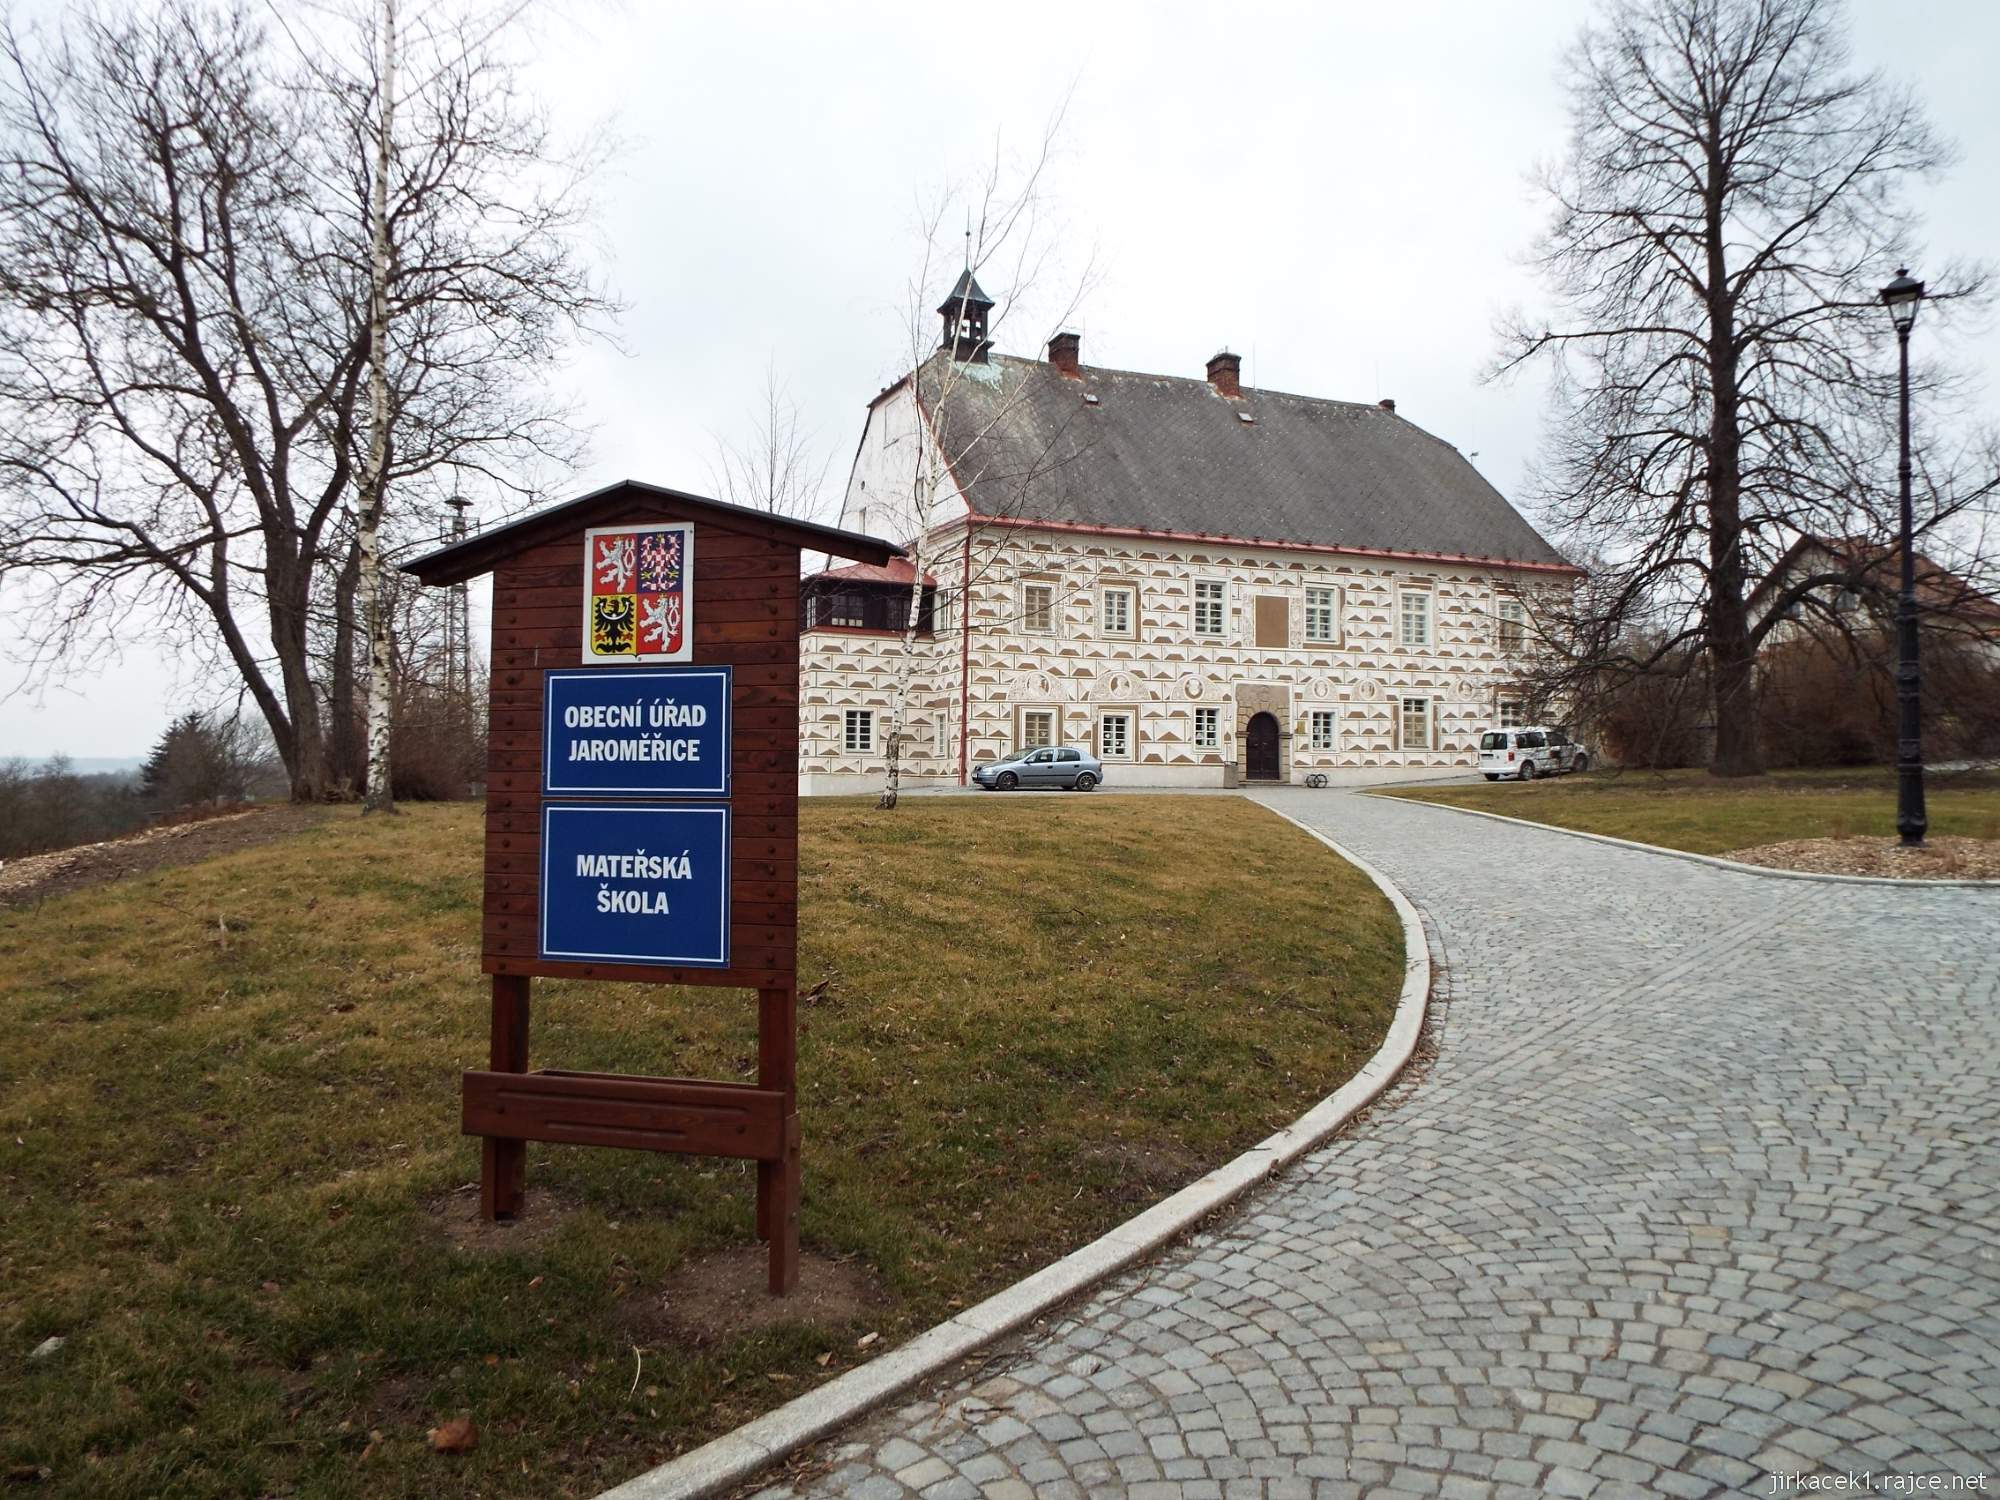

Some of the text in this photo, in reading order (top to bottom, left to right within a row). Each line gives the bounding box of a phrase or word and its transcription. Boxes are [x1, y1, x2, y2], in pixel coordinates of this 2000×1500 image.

[565, 698, 707, 728] OBECNÍ ÚŘAD
[568, 732, 701, 762] JAROMĚŘICE
[576, 848, 693, 880] MATEŘSKÁ
[596, 883, 669, 915] ŠKOLA
